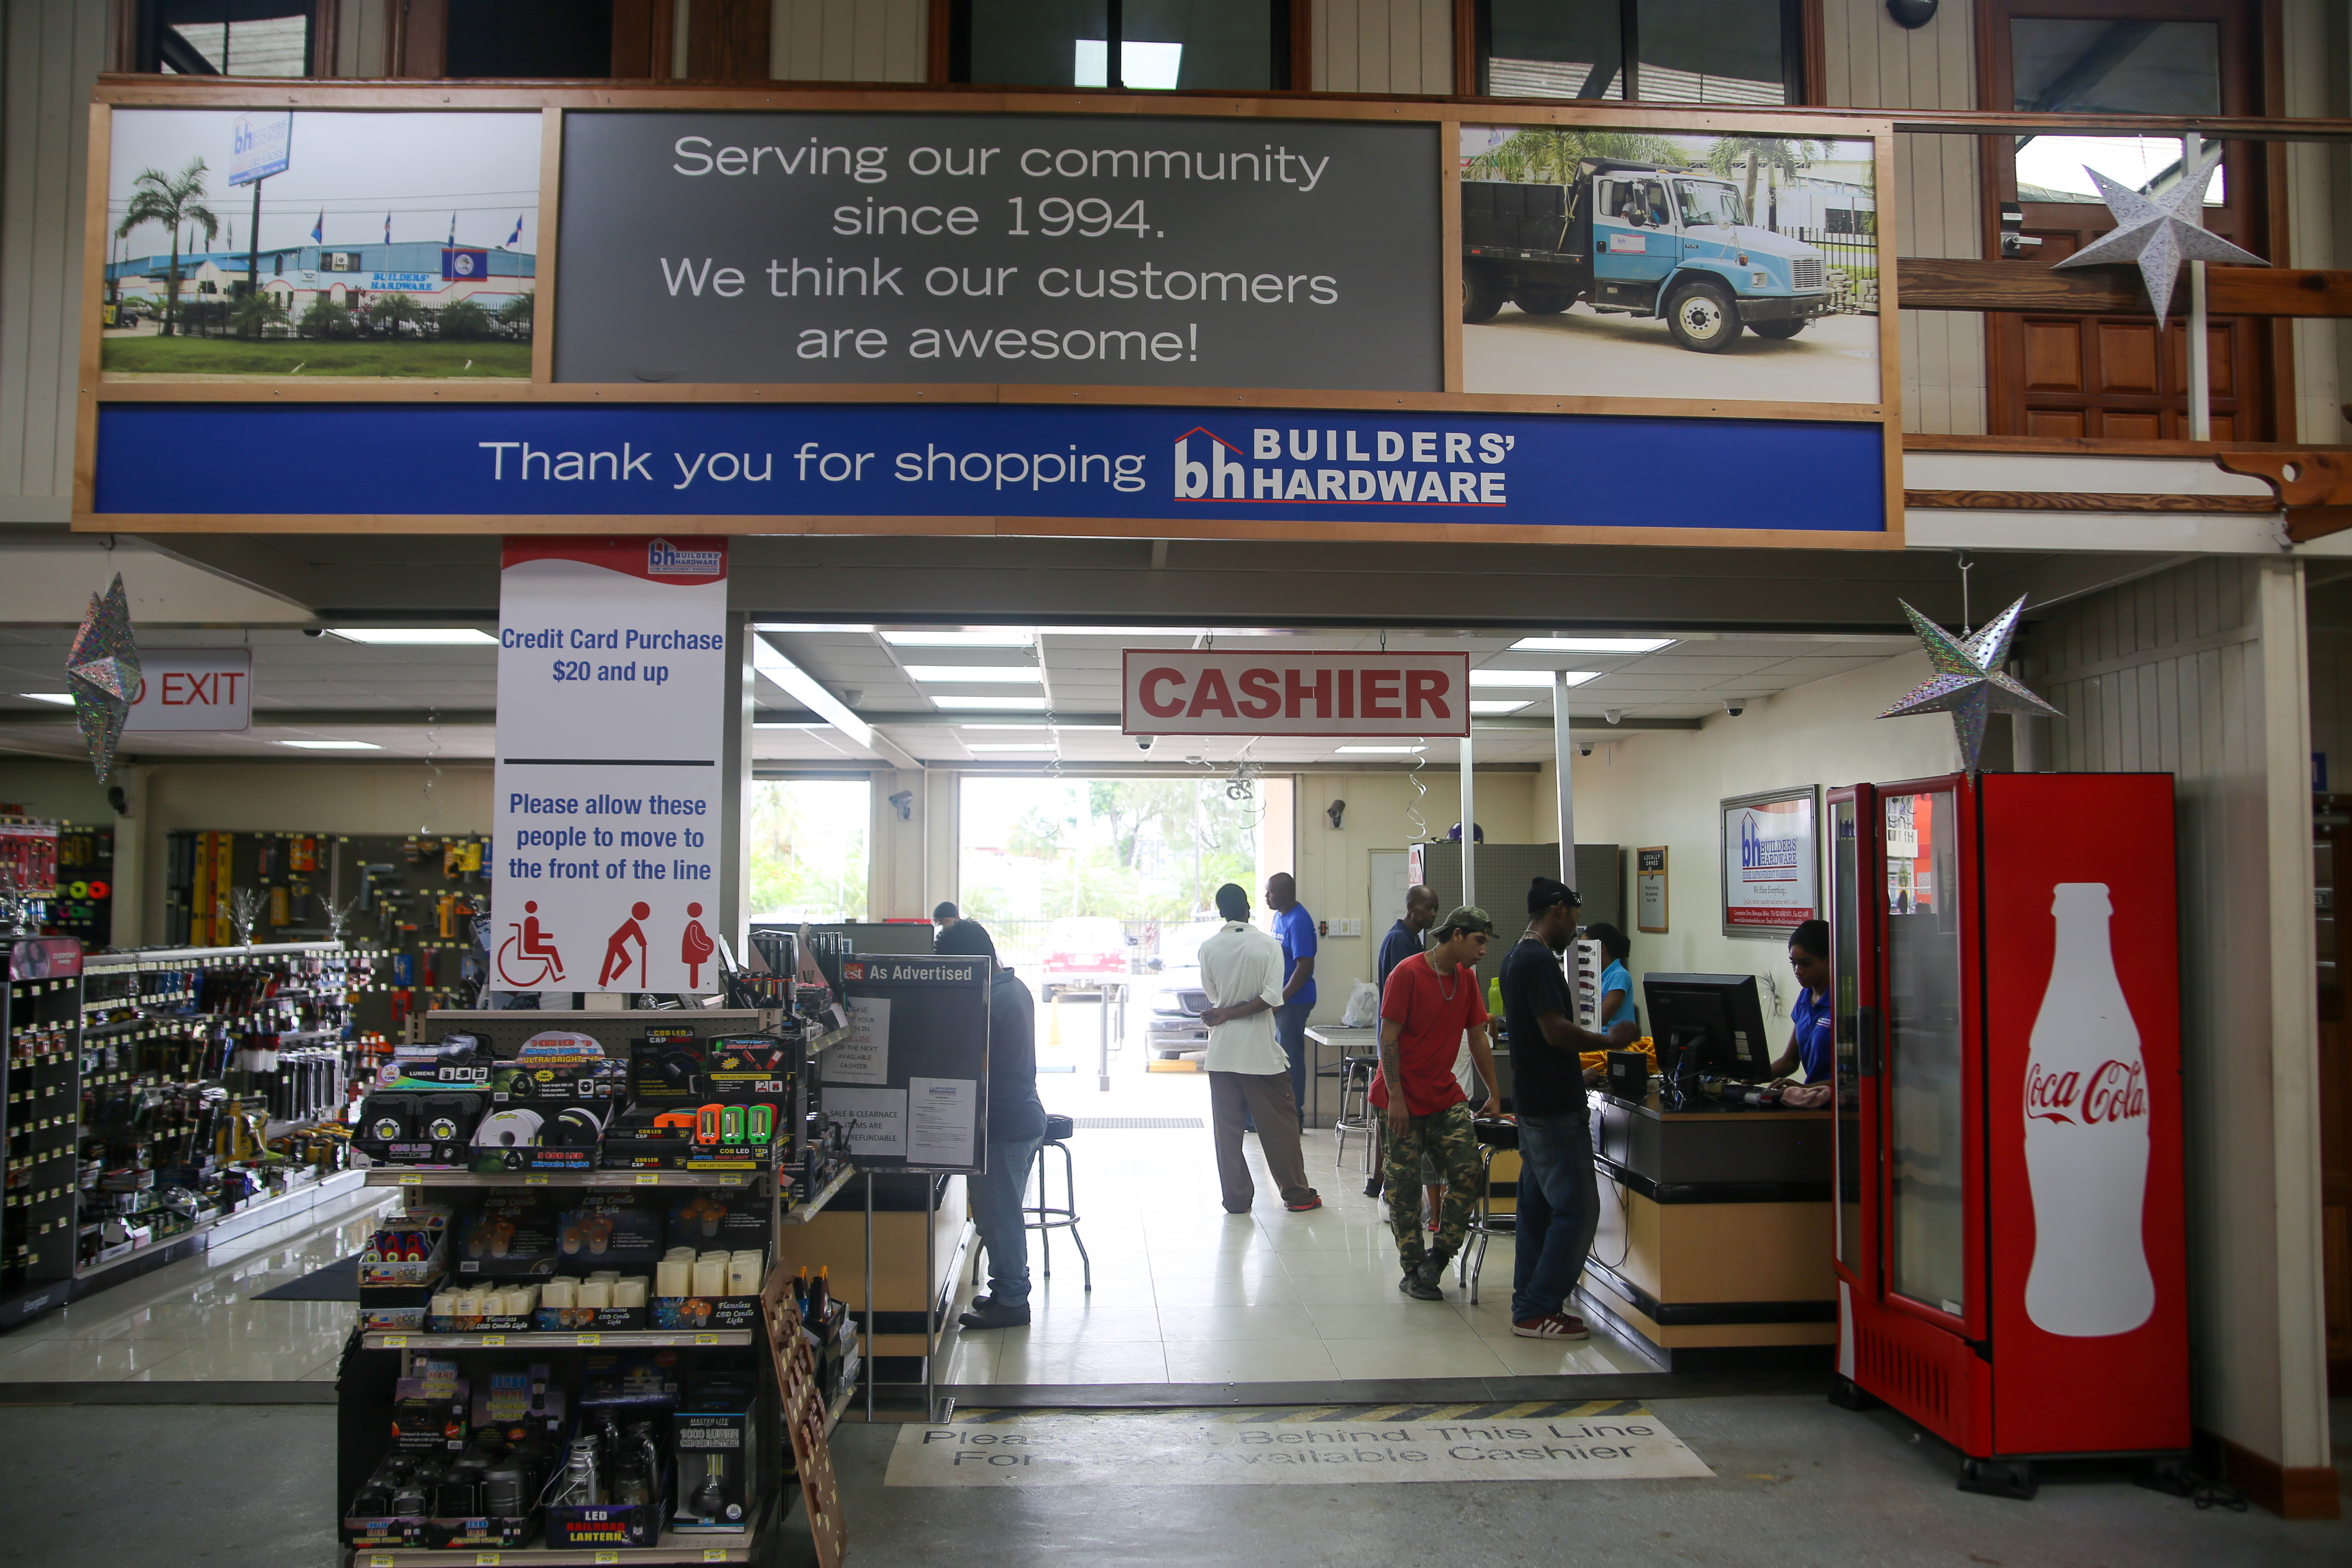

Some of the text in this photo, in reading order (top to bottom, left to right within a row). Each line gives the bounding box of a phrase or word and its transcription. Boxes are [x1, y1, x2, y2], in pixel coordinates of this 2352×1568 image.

[267, 148, 284, 162] BOSS
[673, 136, 1329, 192] Serving our community
[833, 196, 1163, 238] since 1994.
[370, 281, 432, 290] HARDWARE
[373, 273, 429, 282] BUILDERS'
[660, 257, 1338, 304] We think our customers
[797, 324, 1197, 361] are awesome!
[1253, 429, 1515, 465] BUILDERS'
[479, 442, 1145, 492] Thank you for shopping
[1175, 437, 1243, 499] bh
[1252, 467, 1507, 503] HARDWARE
[649, 543, 675, 565] bh
[502, 628, 723, 649] Credit Card Purchase
[553, 659, 668, 685] $20 and up
[161, 672, 244, 705] EXIT
[1139, 668, 1450, 720] CASHIER
[511, 793, 706, 815] Please allow these
[518, 827, 704, 850] people to move to
[1742, 821, 1761, 867] bh
[1761, 837, 1798, 853] BUILDERS'
[509, 858, 710, 880] the front of the line
[1761, 853, 1797, 866] HARDWARE
[1743, 870, 1797, 879] HOME IMPROVEMENT WAREHOUSE
[1759, 885, 1767, 894] Have
[844, 969, 863, 980] est
[870, 965, 972, 980] As Advertised
[2025, 1058, 2147, 1127] Coca Cola
[511, 1322, 528, 1330] Light
[491, 1375, 526, 1389] JUMBO
[680, 1428, 739, 1439] 1000 LUMEN
[680, 1439, 695, 1447] COB
[708, 1439, 739, 1447] LANTERN
[1239, 1423, 1655, 1446] Behind This Line
[1203, 1447, 1429, 1464] Available
[1447, 1444, 1636, 1462] Cashier
[466, 1521, 489, 1529] JUMBO
[567, 1522, 626, 1531] RAILROAD
[585, 1511, 607, 1521] LED
[570, 1532, 622, 1542] LANTERN
